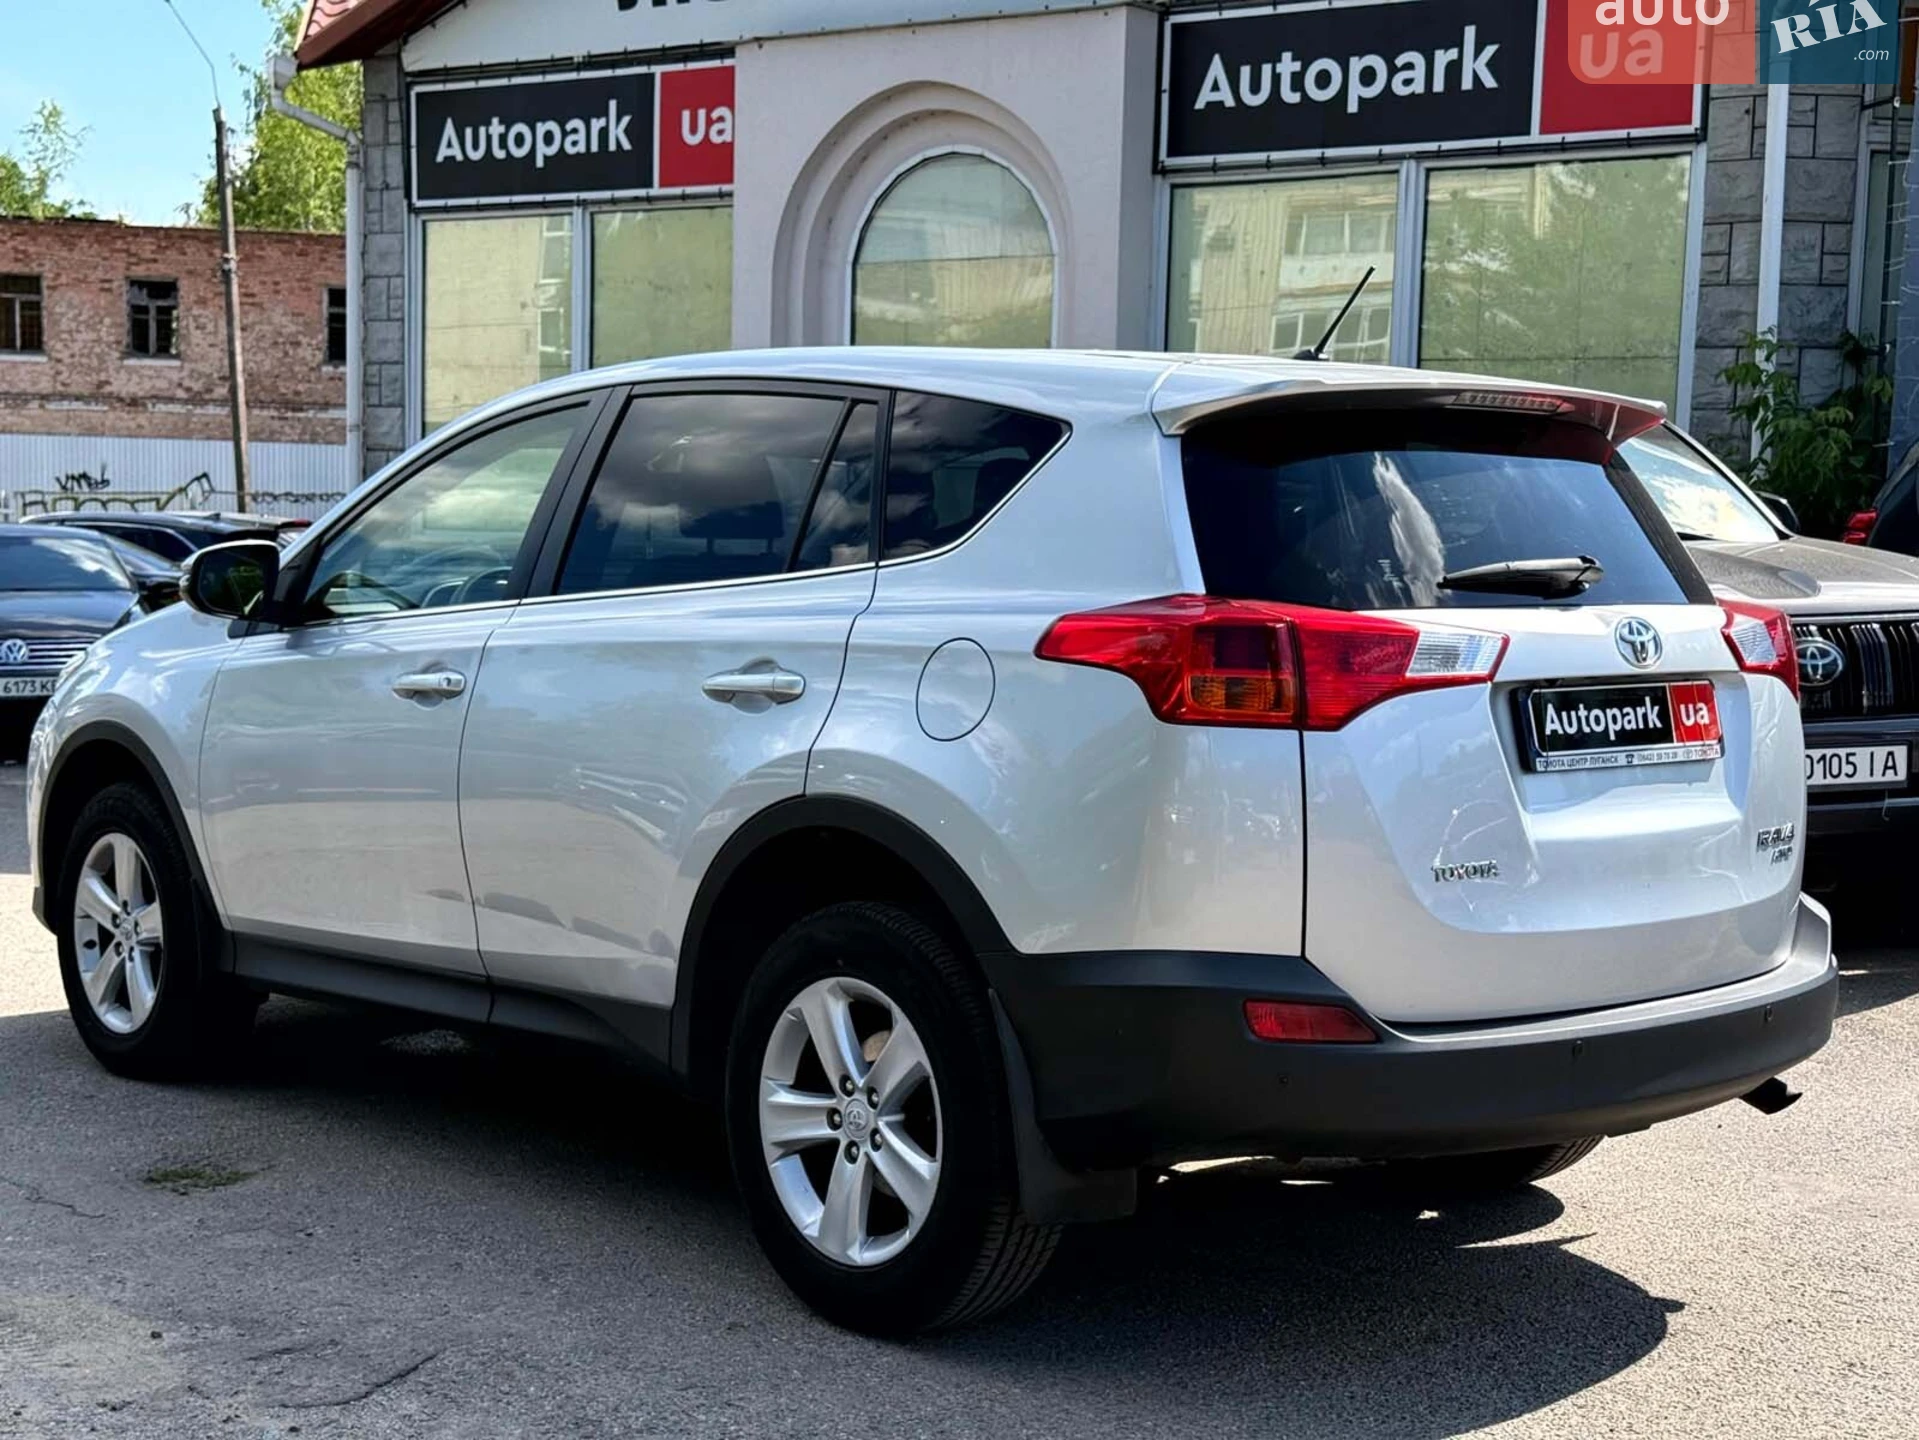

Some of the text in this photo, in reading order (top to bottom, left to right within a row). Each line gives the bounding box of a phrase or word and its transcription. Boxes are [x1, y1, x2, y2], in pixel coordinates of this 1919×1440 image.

[1193, 24, 1663, 114] Autopark ua
[435, 99, 734, 169] Autopark ua
[3, 679, 37, 694] 6173
[1545, 696, 1710, 741] Autopark ua
[1431, 860, 1499, 882] TOYOTA
